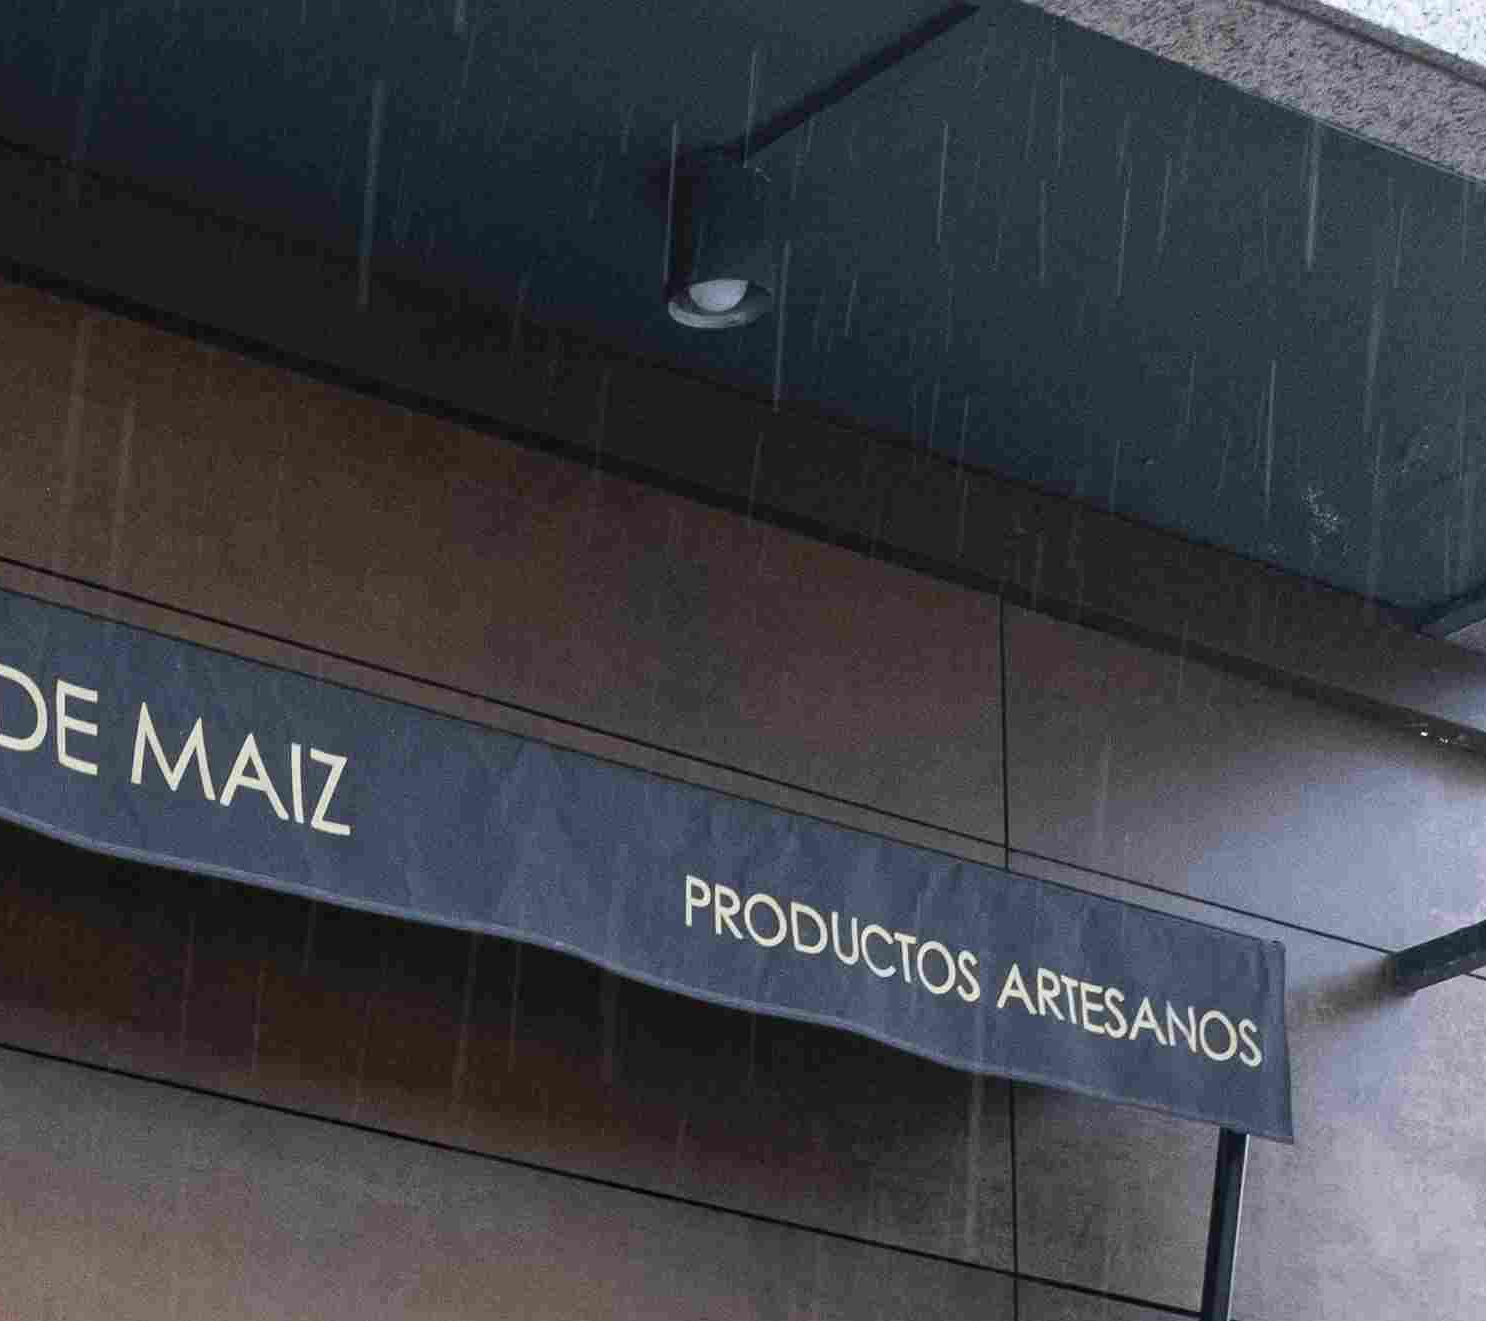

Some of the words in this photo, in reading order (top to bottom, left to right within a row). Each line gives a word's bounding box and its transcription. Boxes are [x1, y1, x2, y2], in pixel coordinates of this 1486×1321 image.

[130, 702, 351, 837] MAIZ
[684, 875, 981, 1002] PRODUCTOS
[996, 963, 1263, 1068] ARTESANOS
